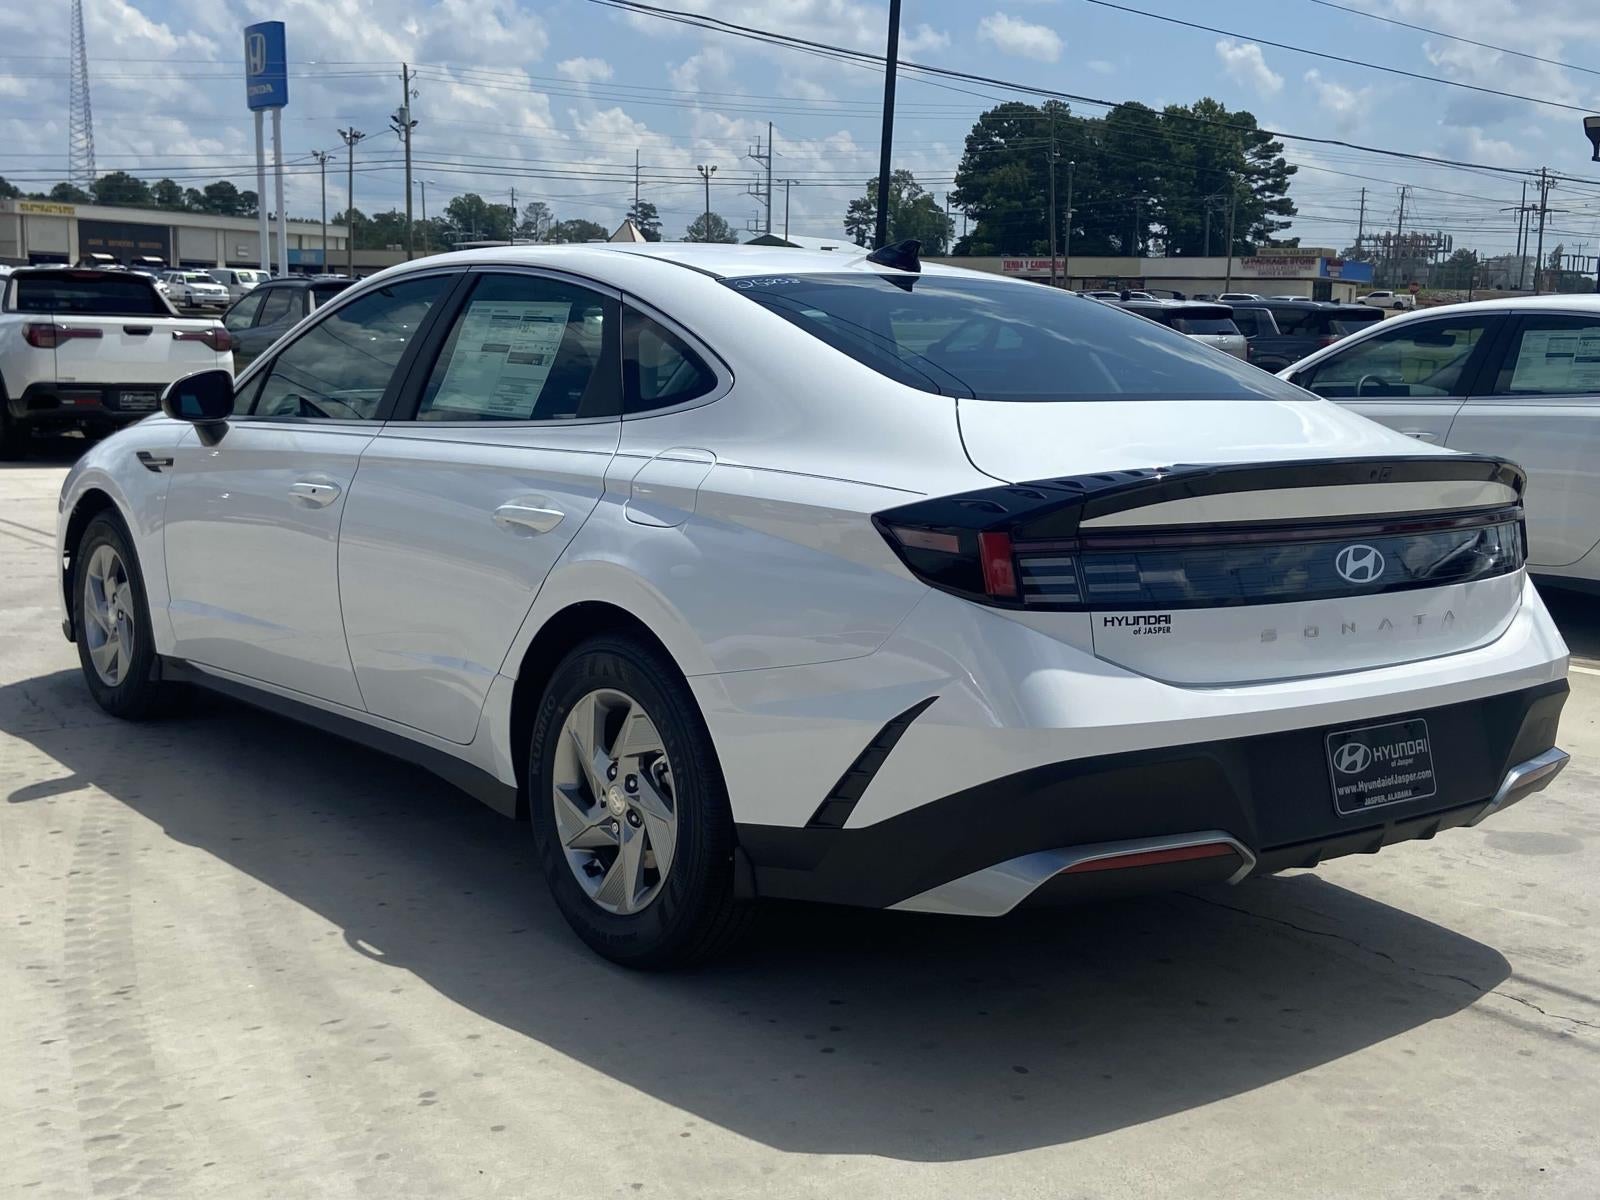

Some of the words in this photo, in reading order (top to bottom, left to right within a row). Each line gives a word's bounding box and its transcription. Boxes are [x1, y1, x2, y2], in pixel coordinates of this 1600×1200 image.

[1289, 257, 1316, 265] STORE
[1103, 614, 1171, 627] HYUNDAI
[1260, 609, 1455, 642] SONATA
[1133, 627, 1141, 635] of
[1143, 626, 1171, 634] JASPER
[1373, 738, 1428, 762] HYUNDAI
[1397, 757, 1414, 766] Jasper
[1337, 769, 1432, 796] www.HyundaiofJasper.com
[1387, 789, 1413, 801] ALABAMA
